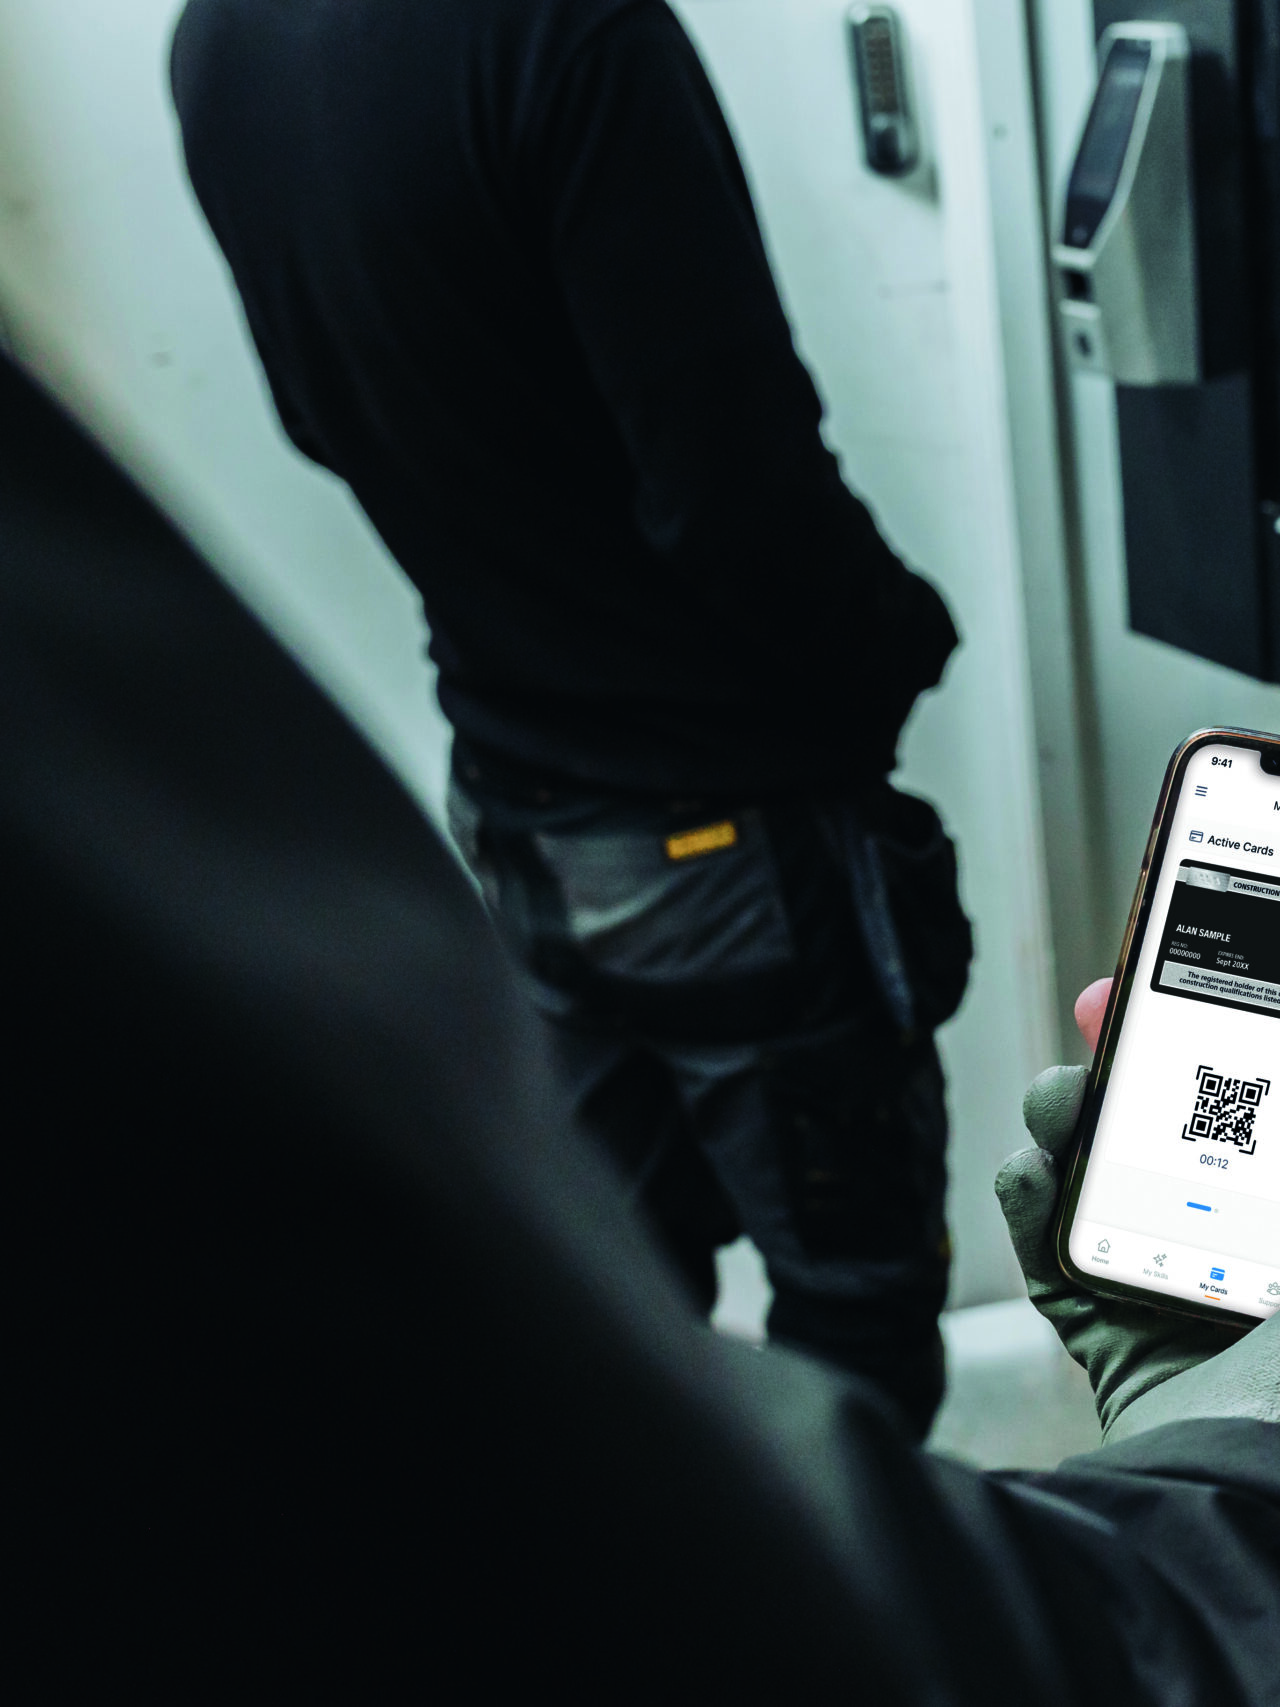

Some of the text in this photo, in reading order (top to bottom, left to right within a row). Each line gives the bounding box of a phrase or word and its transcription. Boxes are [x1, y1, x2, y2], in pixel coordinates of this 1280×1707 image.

[1211, 756, 1233, 769] 9:41
[1207, 835, 1274, 857] Active Cards
[1233, 881, 1280, 897] CONSTRUCTION
[1176, 923, 1231, 943] ALAN SAMPLE
[1169, 947, 1201, 960] 00000000
[1216, 957, 1250, 970] Sept 20XX
[1179, 977, 1218, 991] construction
[1219, 986, 1262, 1000] qualifications
[1188, 970, 1199, 979] The
[1200, 975, 1233, 987] registered
[1234, 981, 1256, 991] holder
[1264, 988, 1277, 996] this
[1200, 1154, 1229, 1170] 00:12
[1091, 1255, 1110, 1265] Home
[1142, 1268, 1169, 1280] My Skills
[1199, 1282, 1228, 1295] My Cards
